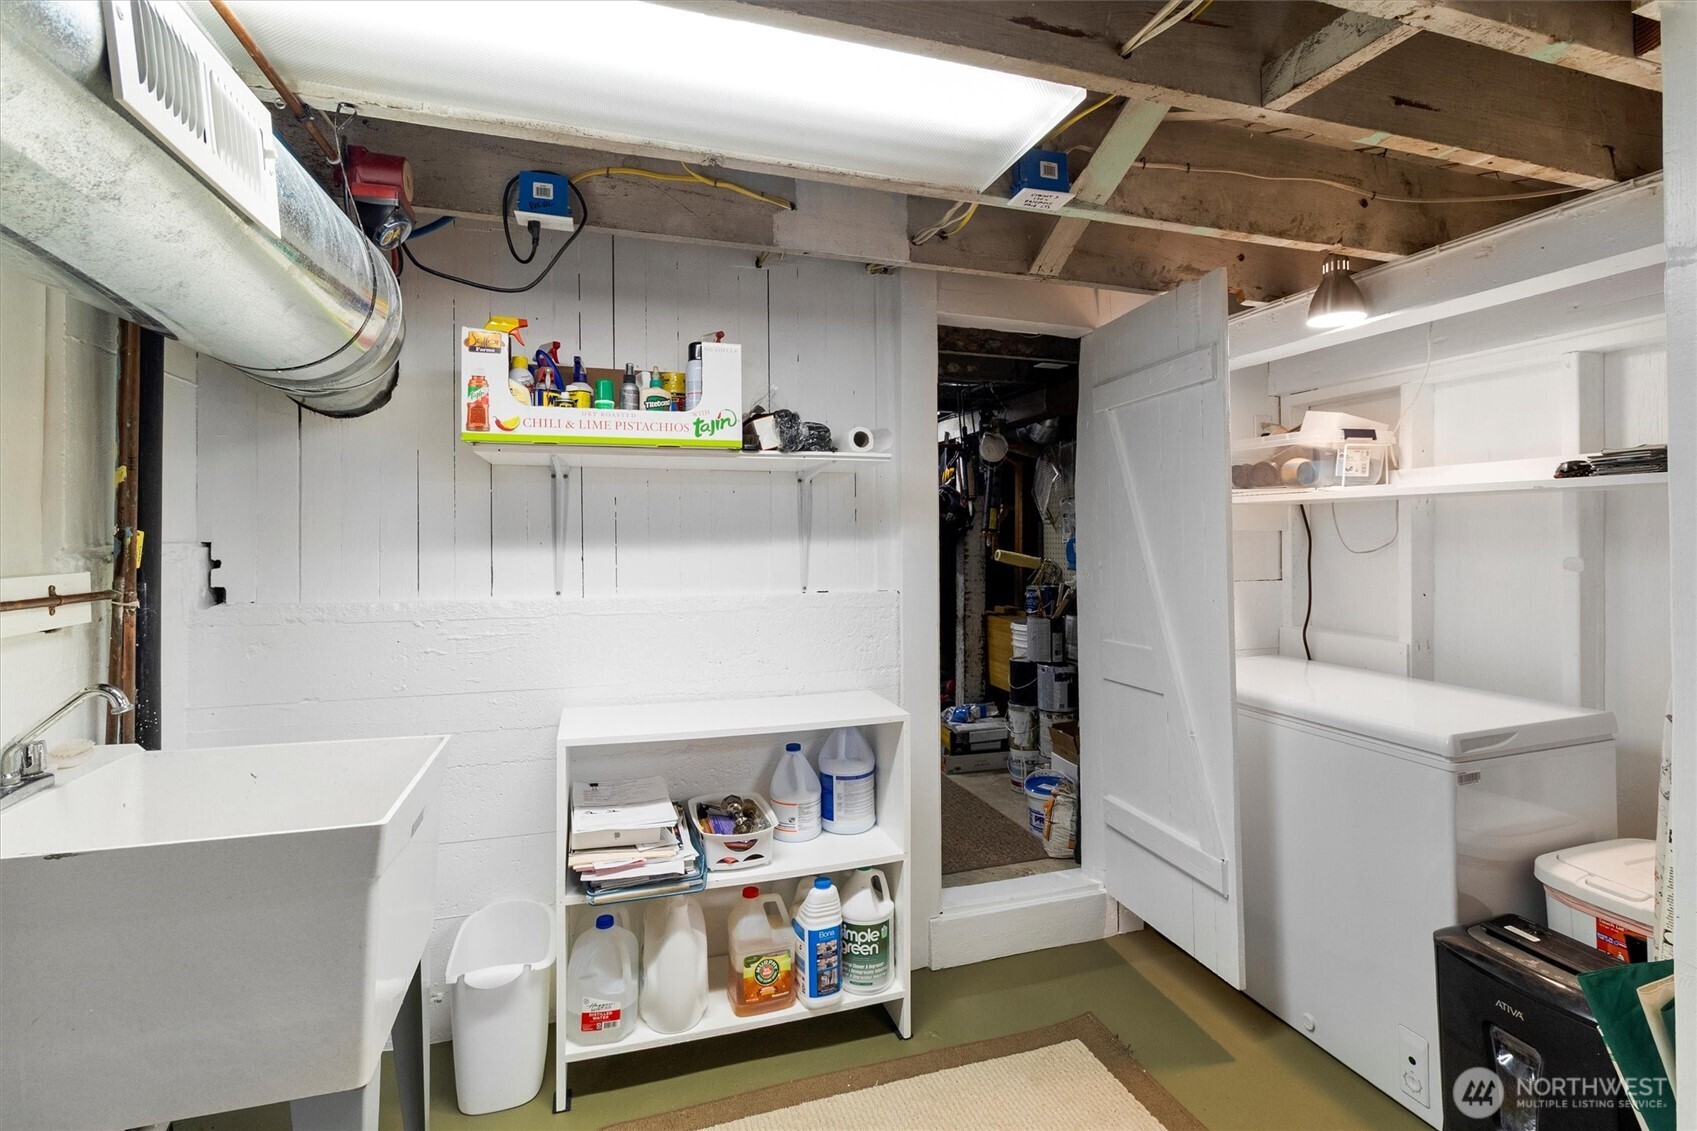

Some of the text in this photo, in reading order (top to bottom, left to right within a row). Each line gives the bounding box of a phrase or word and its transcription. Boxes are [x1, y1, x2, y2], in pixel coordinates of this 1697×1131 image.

[691, 409, 711, 418] WITH
[522, 417, 690, 433] CHILI & LIME PISTACHIOS
[818, 930, 836, 939] Bona
[841, 924, 880, 945] imple
[756, 959, 779, 973] MURPHY
[1495, 999, 1525, 1021] ATIVA
